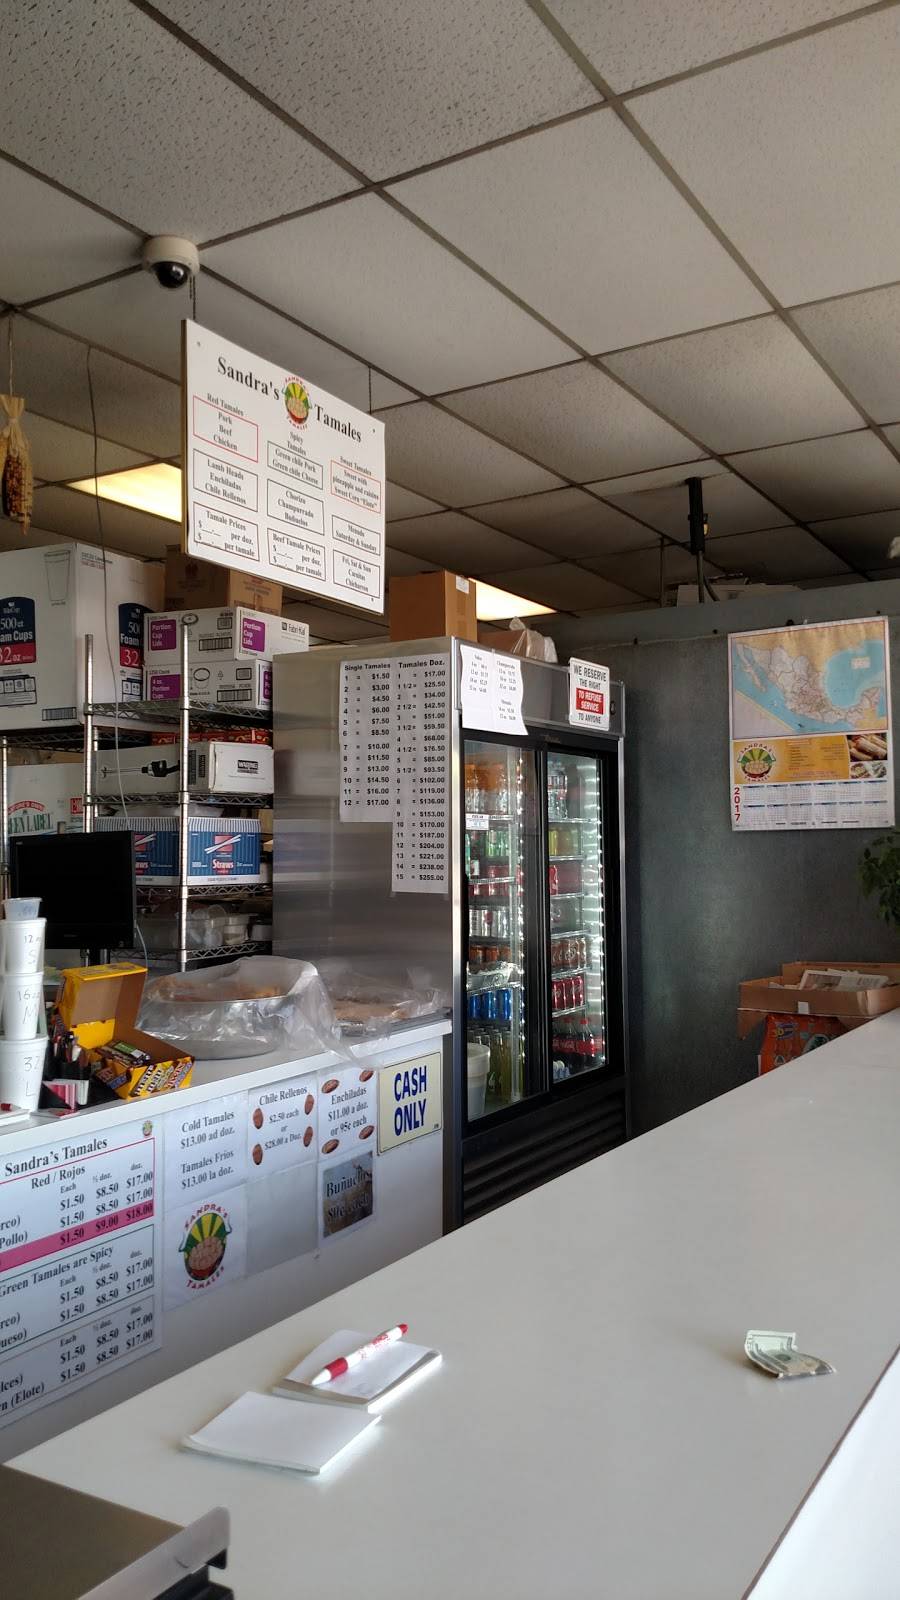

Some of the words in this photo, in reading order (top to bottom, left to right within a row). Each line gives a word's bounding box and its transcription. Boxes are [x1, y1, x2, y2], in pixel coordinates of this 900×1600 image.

[208, 393, 218, 406] Red
[220, 398, 244, 416] Tamales
[218, 356, 280, 400] Sandra's
[315, 404, 362, 443] Tamales
[218, 412, 232, 424] Pork
[219, 424, 232, 436] Beef
[213, 434, 238, 451] Chicken
[210, 472, 242, 492] Enchiladas
[14, 630, 33, 642] Cups
[120, 633, 139, 646] Foam
[244, 630, 253, 638] Cup
[124, 649, 139, 666] 32
[398, 660, 428, 668] Tamales
[344, 664, 362, 672] Single
[574, 664, 582, 676] WE
[584, 666, 606, 682] RESERVE
[580, 678, 588, 686] THE
[588, 680, 600, 690] RIGHT
[578, 690, 586, 700] TO
[587, 692, 602, 703] REFUSE
[581, 700, 599, 712] SERVICE
[578, 712, 585, 720] TO
[586, 714, 601, 724] ANYONE
[212, 858, 234, 869] Straws
[24, 935, 33, 944] 12
[18, 988, 30, 1001] 16
[394, 1066, 426, 1102] CASH
[260, 1094, 278, 1106] Chile
[280, 1086, 308, 1100] Rellenos
[332, 1086, 366, 1105] Enchiladas
[182, 1120, 200, 1132] Cold
[204, 1110, 234, 1126] Tamales
[286, 1108, 299, 1118] each
[328, 1108, 350, 1122] $11.00
[356, 1101, 368, 1111] doz.
[394, 1098, 426, 1136] ONLY
[330, 1127, 339, 1136] or
[353, 1115, 367, 1128] each
[180, 1134, 206, 1149] $13.00
[220, 1126, 234, 1137] doz.
[4, 1150, 58, 1176] Sandra's
[62, 1138, 108, 1160] Tamales
[182, 1158, 212, 1174] Tamales
[215, 1150, 234, 1162] Frios
[31, 1174, 50, 1189] Red
[60, 1165, 86, 1182] Rojos
[60, 1183, 76, 1194] Each
[131, 1162, 142, 1170] doz.
[181, 1174, 207, 1190] $13.00
[210, 1170, 216, 1180] la
[218, 1166, 234, 1178] doz.
[60, 1194, 84, 1210] $1.50
[96, 1182, 118, 1199] $8.50
[126, 1172, 153, 1188] $17.00
[60, 1210, 84, 1228] $1.50
[96, 1199, 118, 1216] $8.50
[126, 1187, 153, 1205] $17.00
[60, 1228, 84, 1245] $1.50
[96, 1215, 118, 1232] $9.00
[126, 1203, 153, 1221] $18.00
[0, 1280, 28, 1298] Green
[32, 1262, 70, 1284] Tamales
[73, 1254, 88, 1266] are
[90, 1246, 113, 1262] Spicy
[60, 1286, 84, 1304] $1.50
[96, 1272, 118, 1289] $8.50
[126, 1257, 153, 1276] $17.00
[60, 1275, 76, 1288] Each
[186, 1266, 225, 1290] TAMALES
[60, 1303, 84, 1322] $1.50
[96, 1288, 118, 1306] $8.50
[126, 1274, 153, 1293] $17.00
[60, 1344, 85, 1364] $1.50
[96, 1328, 119, 1348] $8.50
[126, 1312, 153, 1332] $17.00
[60, 1334, 76, 1348] Each
[60, 1362, 86, 1382] $1.50
[96, 1345, 119, 1364] $8.50
[126, 1329, 153, 1350] $17.00
[11, 1382, 44, 1408] (Elote)
